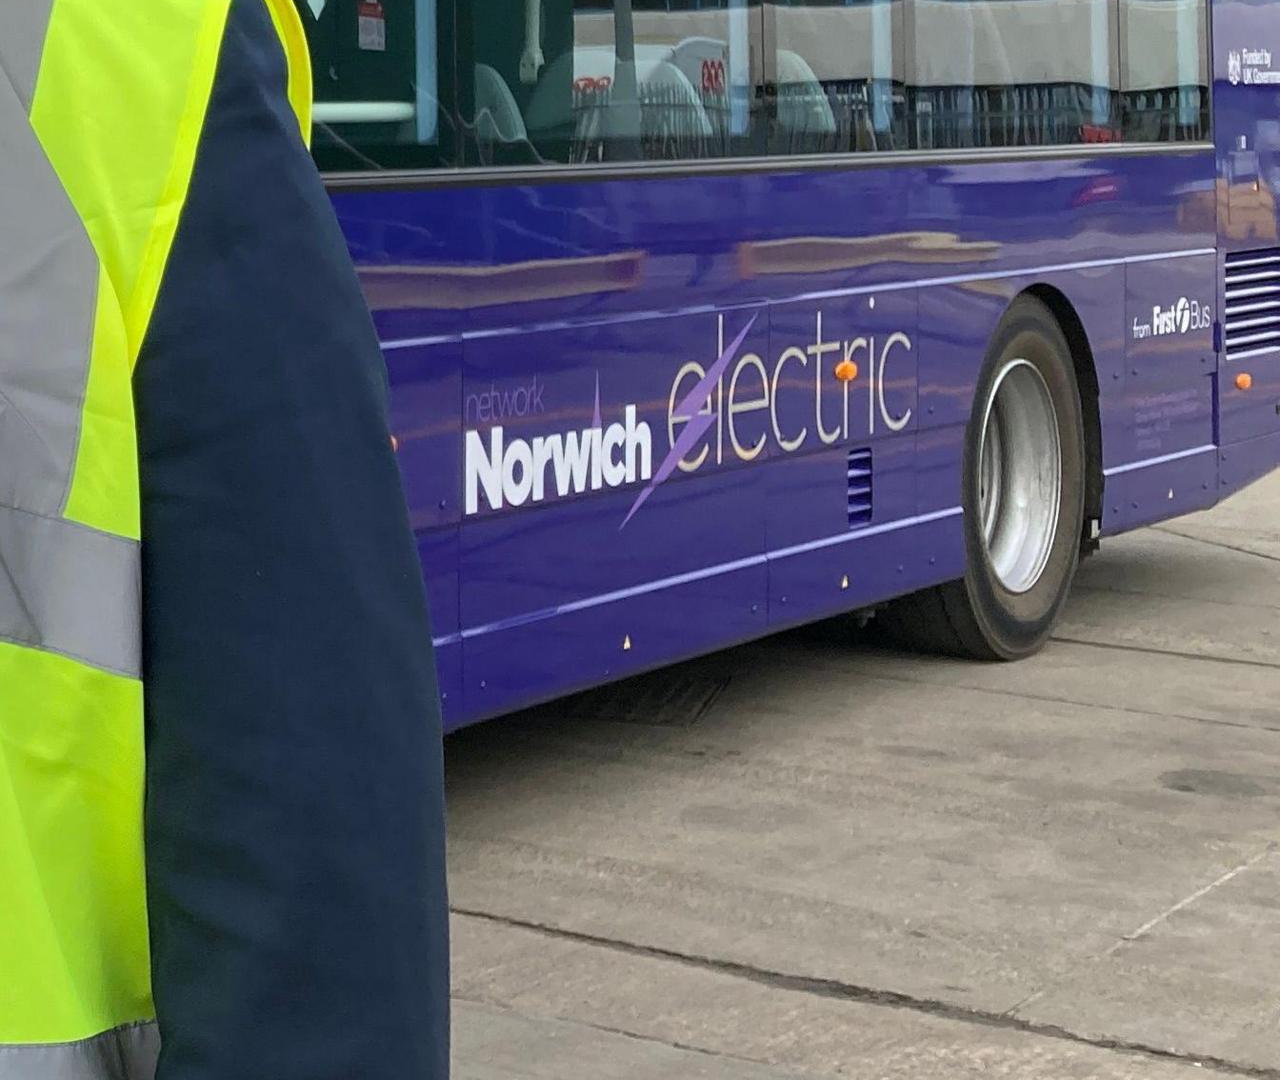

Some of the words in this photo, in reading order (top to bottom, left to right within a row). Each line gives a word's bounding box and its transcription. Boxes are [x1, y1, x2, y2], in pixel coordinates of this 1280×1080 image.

[1133, 317, 1152, 339] from
[1153, 305, 1176, 336] First
[1190, 300, 1210, 329] Bus
[465, 404, 653, 516] Norwich
[667, 310, 912, 474] electric
[466, 374, 545, 423] network
